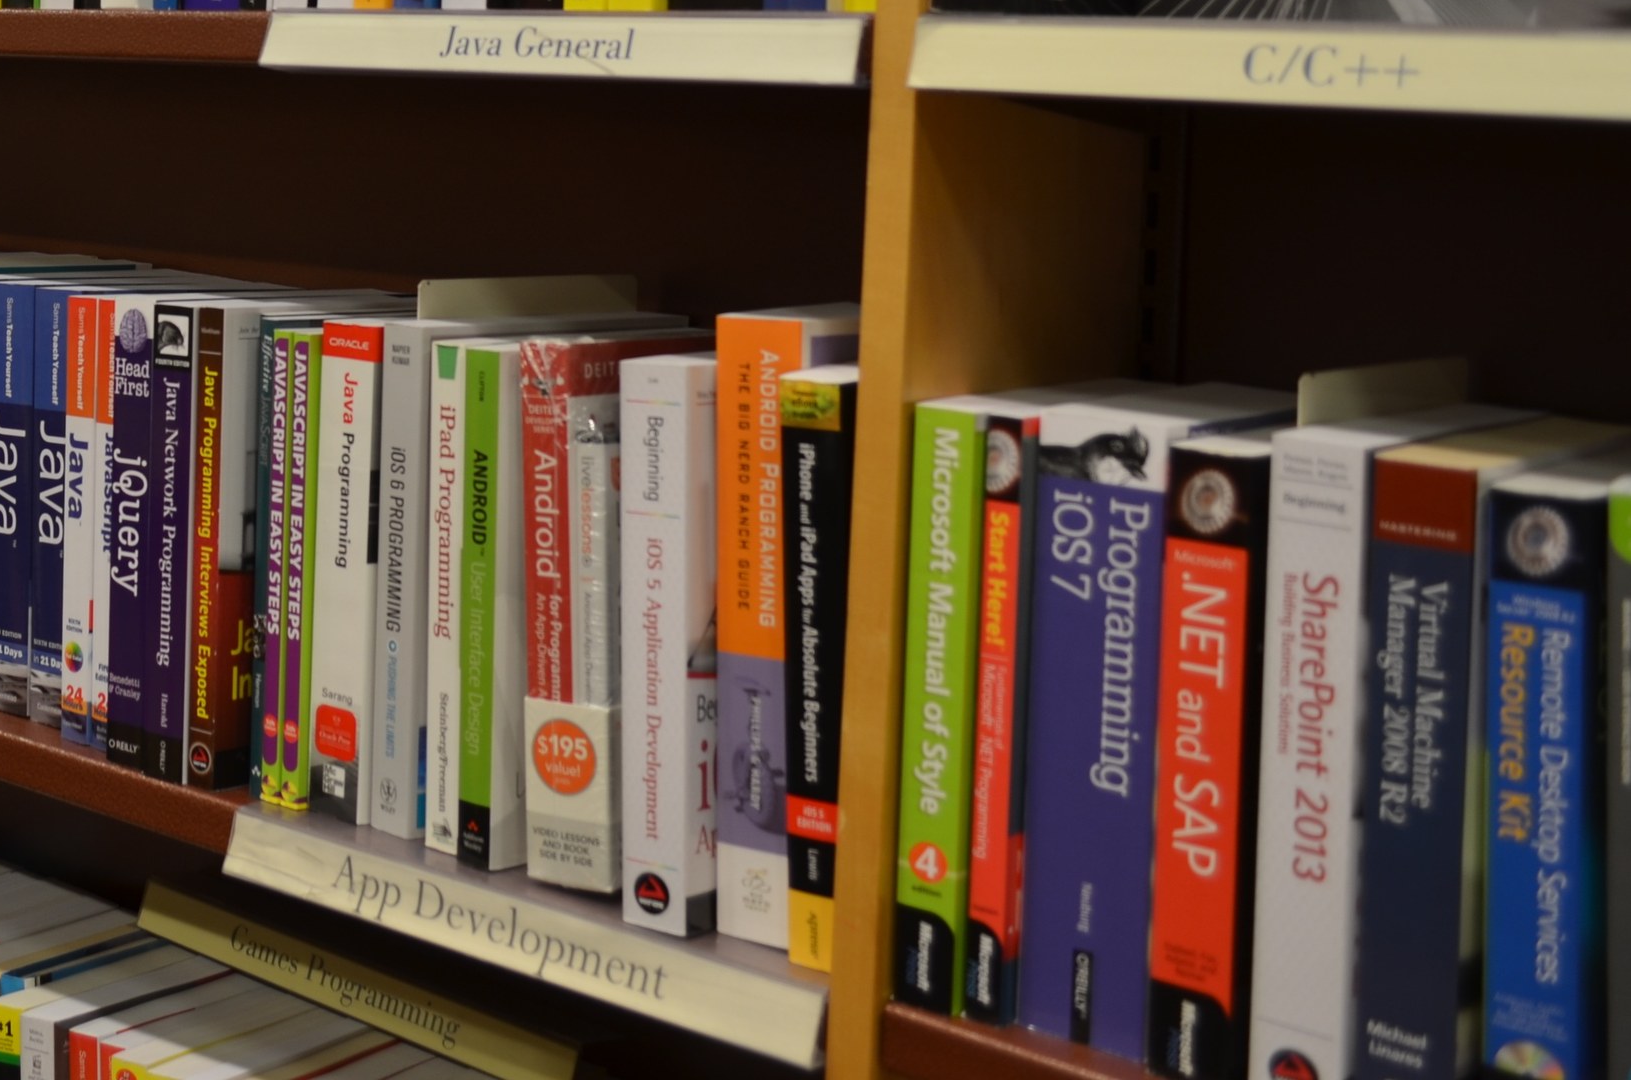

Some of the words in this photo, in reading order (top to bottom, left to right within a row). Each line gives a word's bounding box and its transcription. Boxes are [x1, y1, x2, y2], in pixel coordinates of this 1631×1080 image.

[440, 26, 503, 63] Java
[512, 27, 634, 65] General
[1242, 46, 1420, 88] C/C++
[114, 378, 149, 397] First
[115, 358, 149, 378] Head
[163, 378, 180, 422] Java
[203, 366, 217, 410] Java
[271, 348, 286, 475] JAVASCRIPT
[758, 348, 779, 449] ANDROID
[162, 429, 179, 521] Network
[198, 416, 216, 539] Programming
[439, 404, 455, 461] iPad
[110, 449, 147, 596] jQuery
[271, 479, 282, 503] IN
[533, 448, 561, 578] Android
[930, 426, 959, 576] Microsoft
[1052, 489, 1094, 563] iOS
[270, 510, 282, 565] EASY
[434, 468, 455, 639] Programming
[758, 459, 780, 627] PROGRAMMING
[156, 525, 176, 668] Programming
[198, 545, 213, 637] Interviews
[267, 571, 281, 635] STEPS
[1050, 574, 1090, 601] 7
[1180, 570, 1225, 687] .NET
[1419, 581, 1448, 678] Virtual
[923, 582, 954, 696] Manual
[1090, 499, 1149, 797] Programming
[1296, 571, 1338, 780] SharePoint
[1378, 574, 1414, 696] Manager
[196, 644, 210, 720] Exposed
[925, 701, 945, 726] of
[1176, 692, 1202, 761] and
[1498, 623, 1532, 783] Resource
[1543, 627, 1570, 738] Remote
[536, 738, 588, 761] $195
[545, 761, 581, 776] value!
[917, 730, 946, 816] Style
[1382, 703, 1409, 774] 2008
[1412, 686, 1442, 809] Machine
[1171, 773, 1220, 878] SAP
[1291, 791, 1327, 882] 2013
[1379, 783, 1405, 824] R2
[1498, 790, 1531, 844] Kit
[1537, 746, 1569, 864] Desktop
[331, 855, 400, 916] App
[415, 880, 667, 1000] Development
[1536, 871, 1567, 984] Services
[230, 925, 298, 973] Games
[306, 955, 460, 1047] Programming
